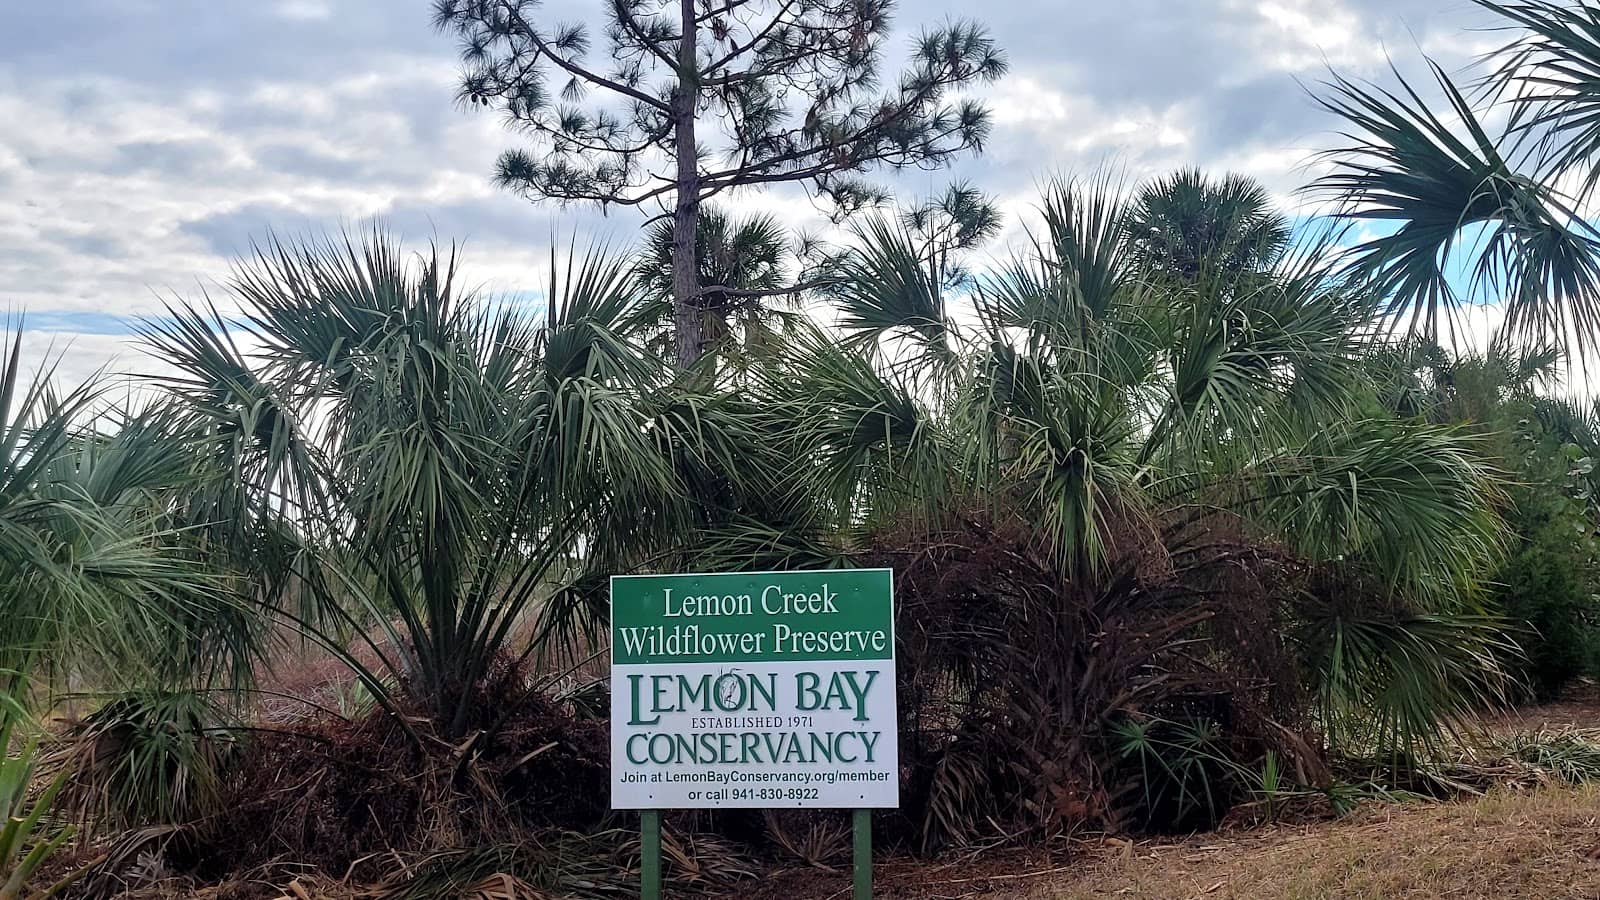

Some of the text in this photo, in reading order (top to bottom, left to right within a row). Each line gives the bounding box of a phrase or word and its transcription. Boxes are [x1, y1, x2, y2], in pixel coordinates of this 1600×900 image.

[663, 583, 839, 617] Lemon Creek
[619, 624, 886, 656] Wildflower Preserve
[626, 670, 880, 726] LEMON BAY
[692, 716, 813, 729] ESTABLISHED 1971
[626, 731, 881, 765] CONSERVANCY
[620, 770, 890, 784] Join at LemonBayConservancy.org/member
[688, 788, 819, 800] or call 941-830-8922
